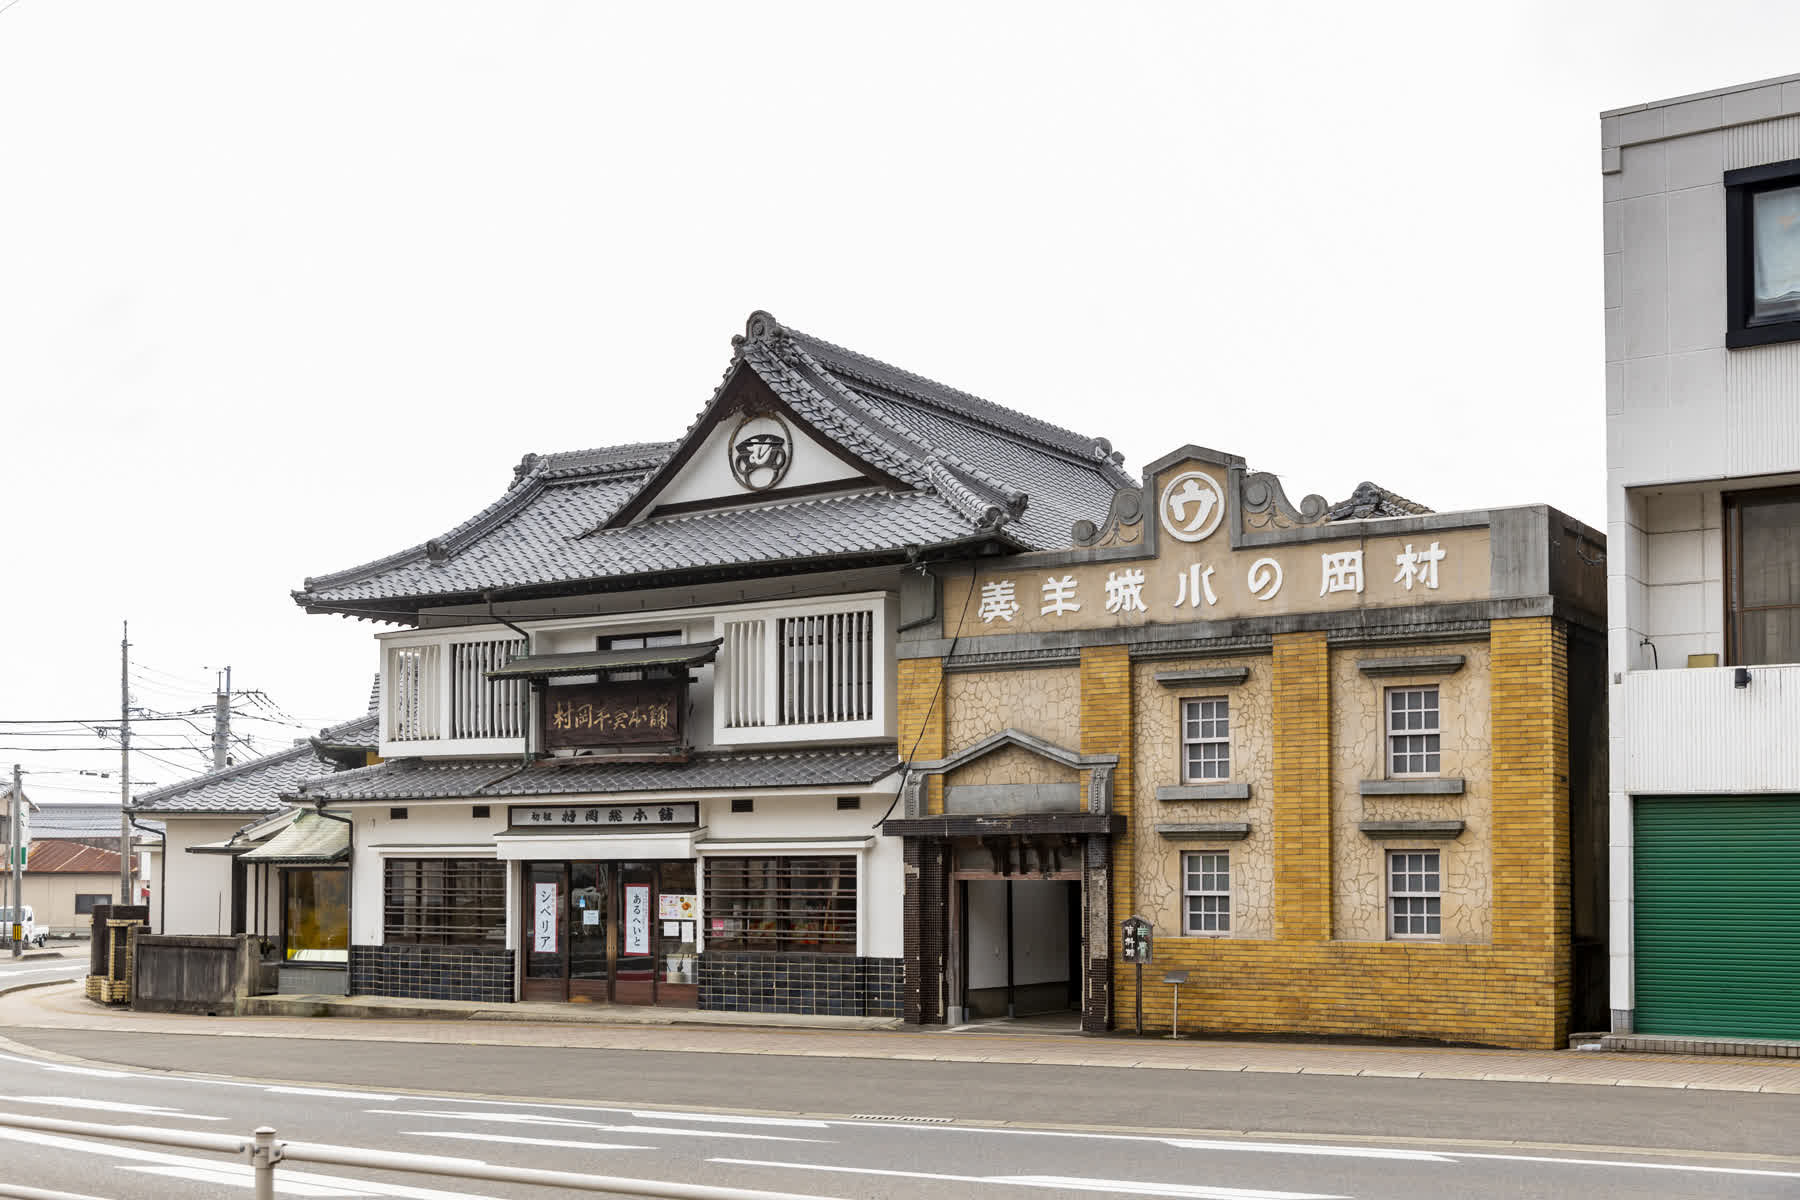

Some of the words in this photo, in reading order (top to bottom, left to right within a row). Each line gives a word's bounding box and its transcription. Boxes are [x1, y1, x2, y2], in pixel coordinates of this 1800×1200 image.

[540, 890, 552, 949] シベリア
[632, 893, 642, 947] あるへいと
